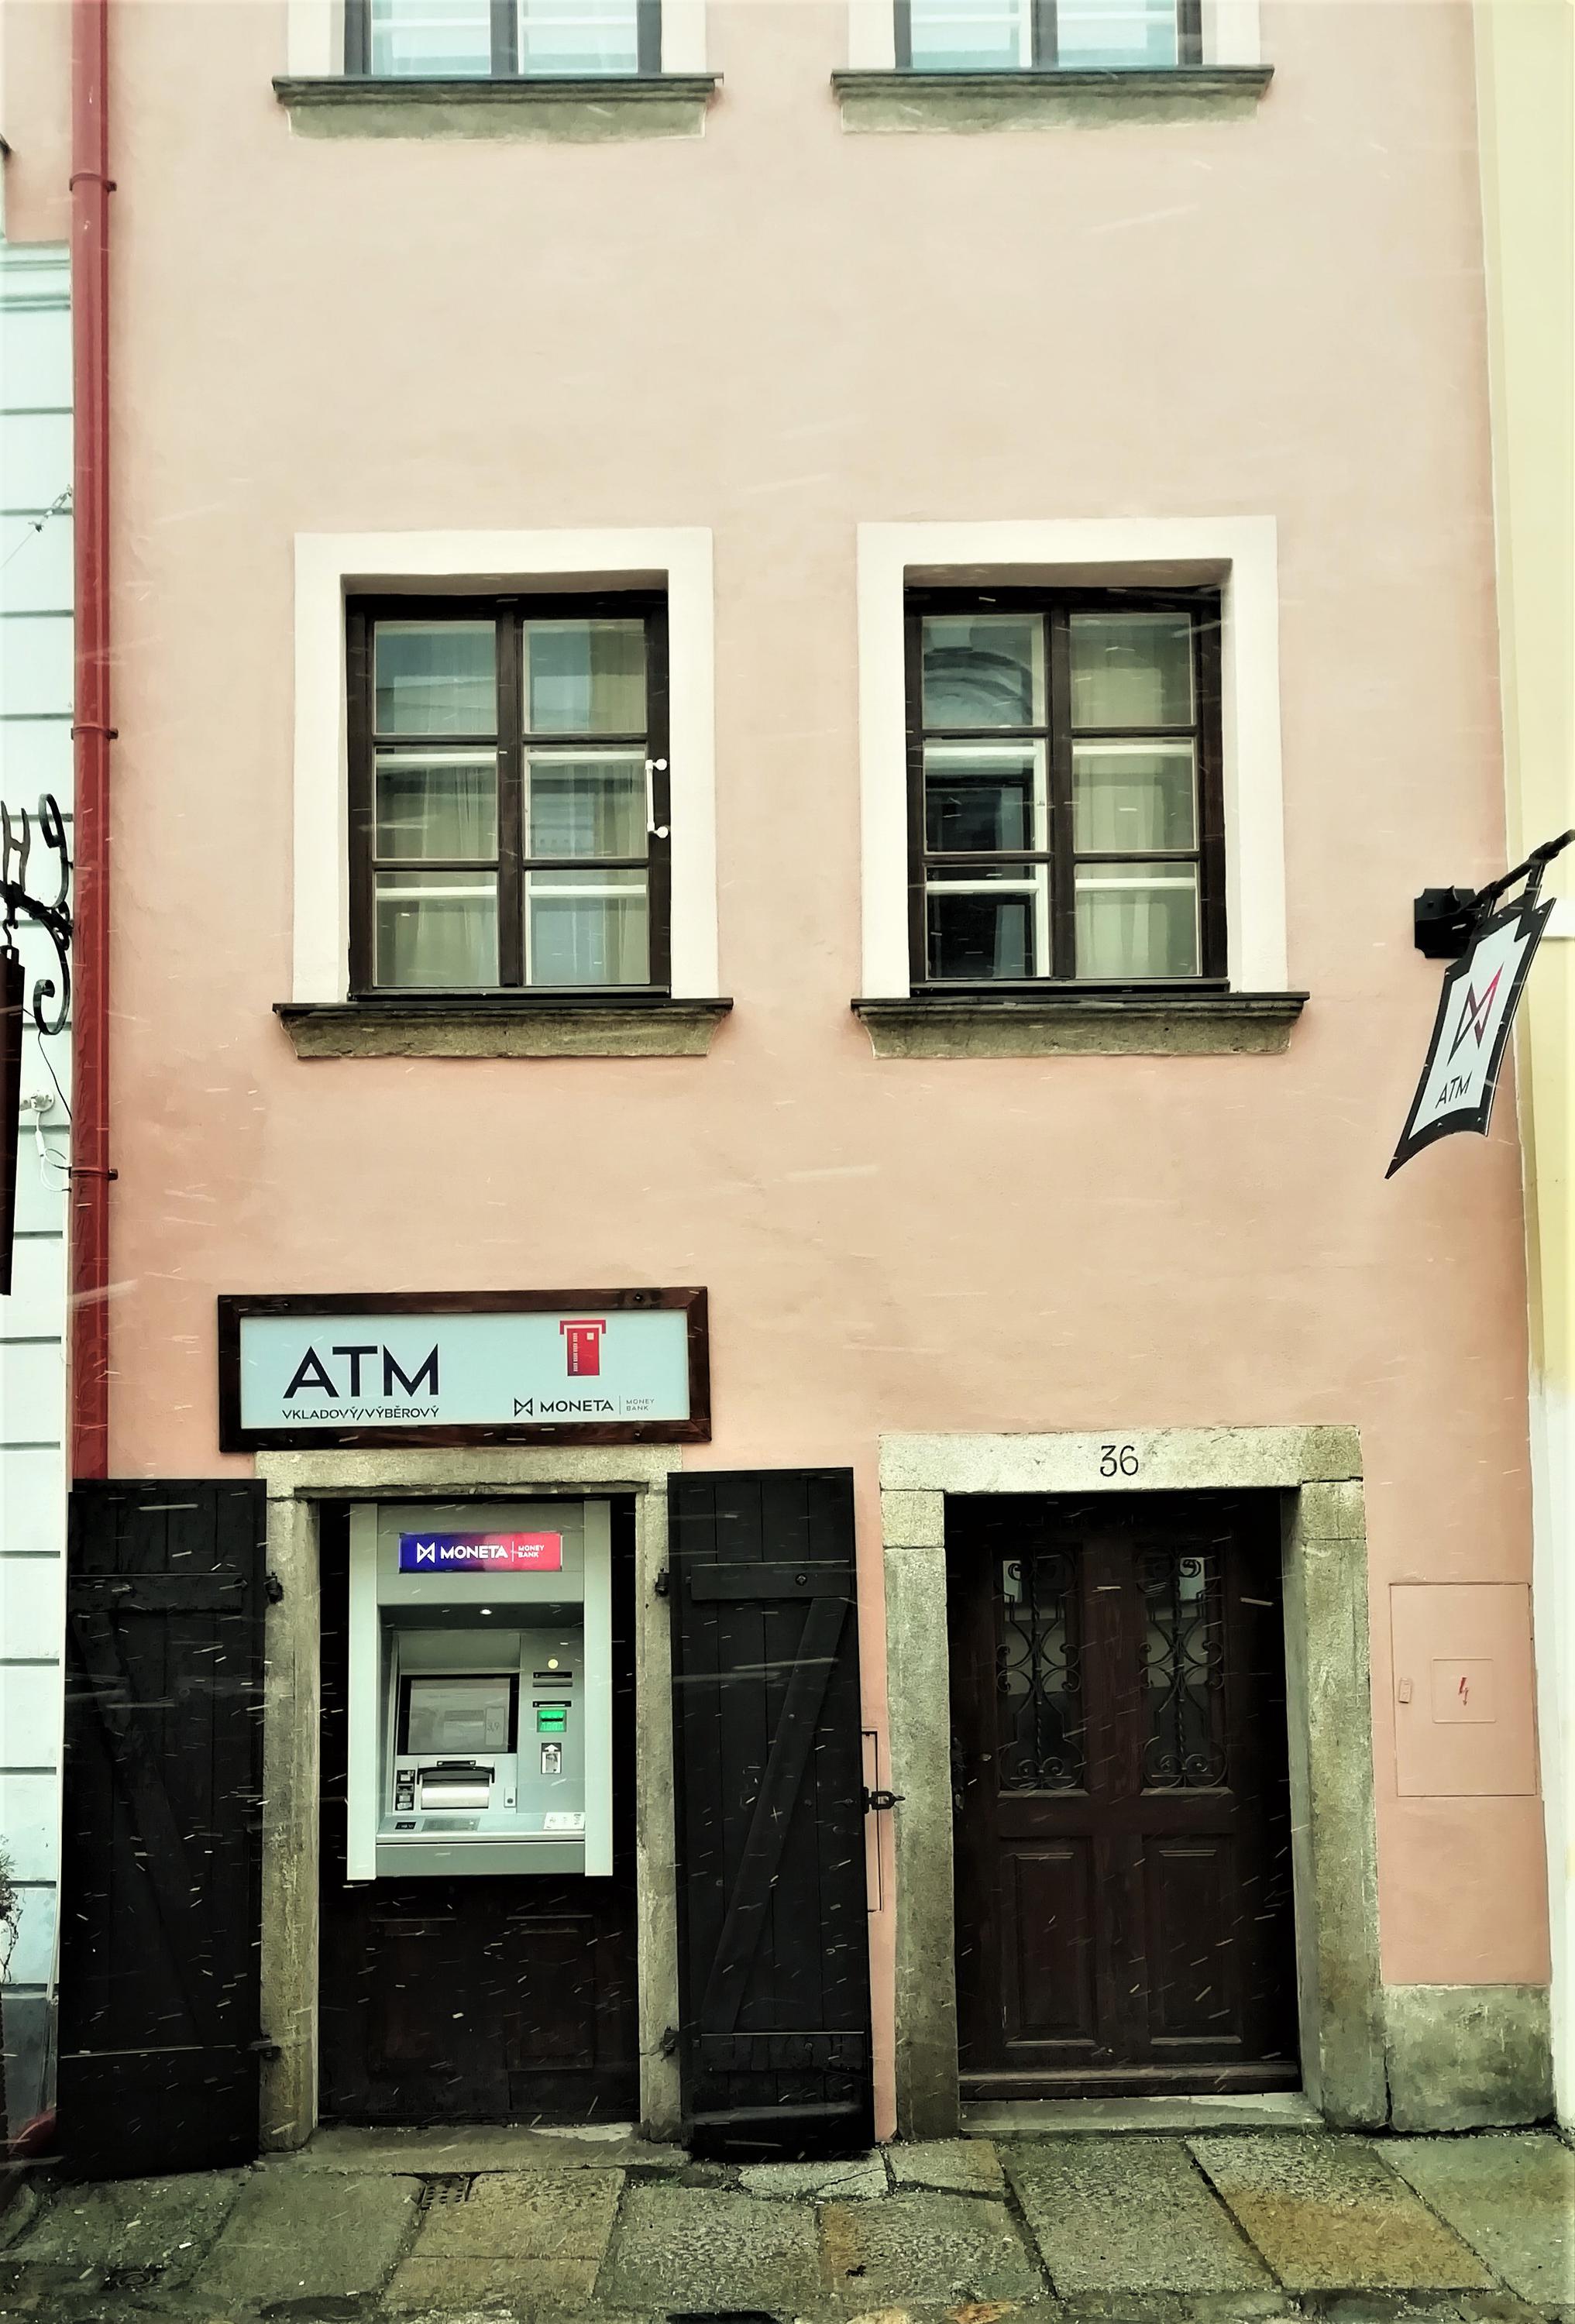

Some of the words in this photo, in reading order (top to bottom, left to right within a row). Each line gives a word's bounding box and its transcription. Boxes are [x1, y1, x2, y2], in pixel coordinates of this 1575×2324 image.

[1435, 1069, 1473, 1109] ATM
[282, 1342, 439, 1399] ATM
[282, 1405, 439, 1421] VKLADOVÝ/VÝBĚROVÝ
[540, 1400, 614, 1412] MONETA
[1100, 1445, 1139, 1477] 36
[440, 1545, 508, 1559] MONETA
